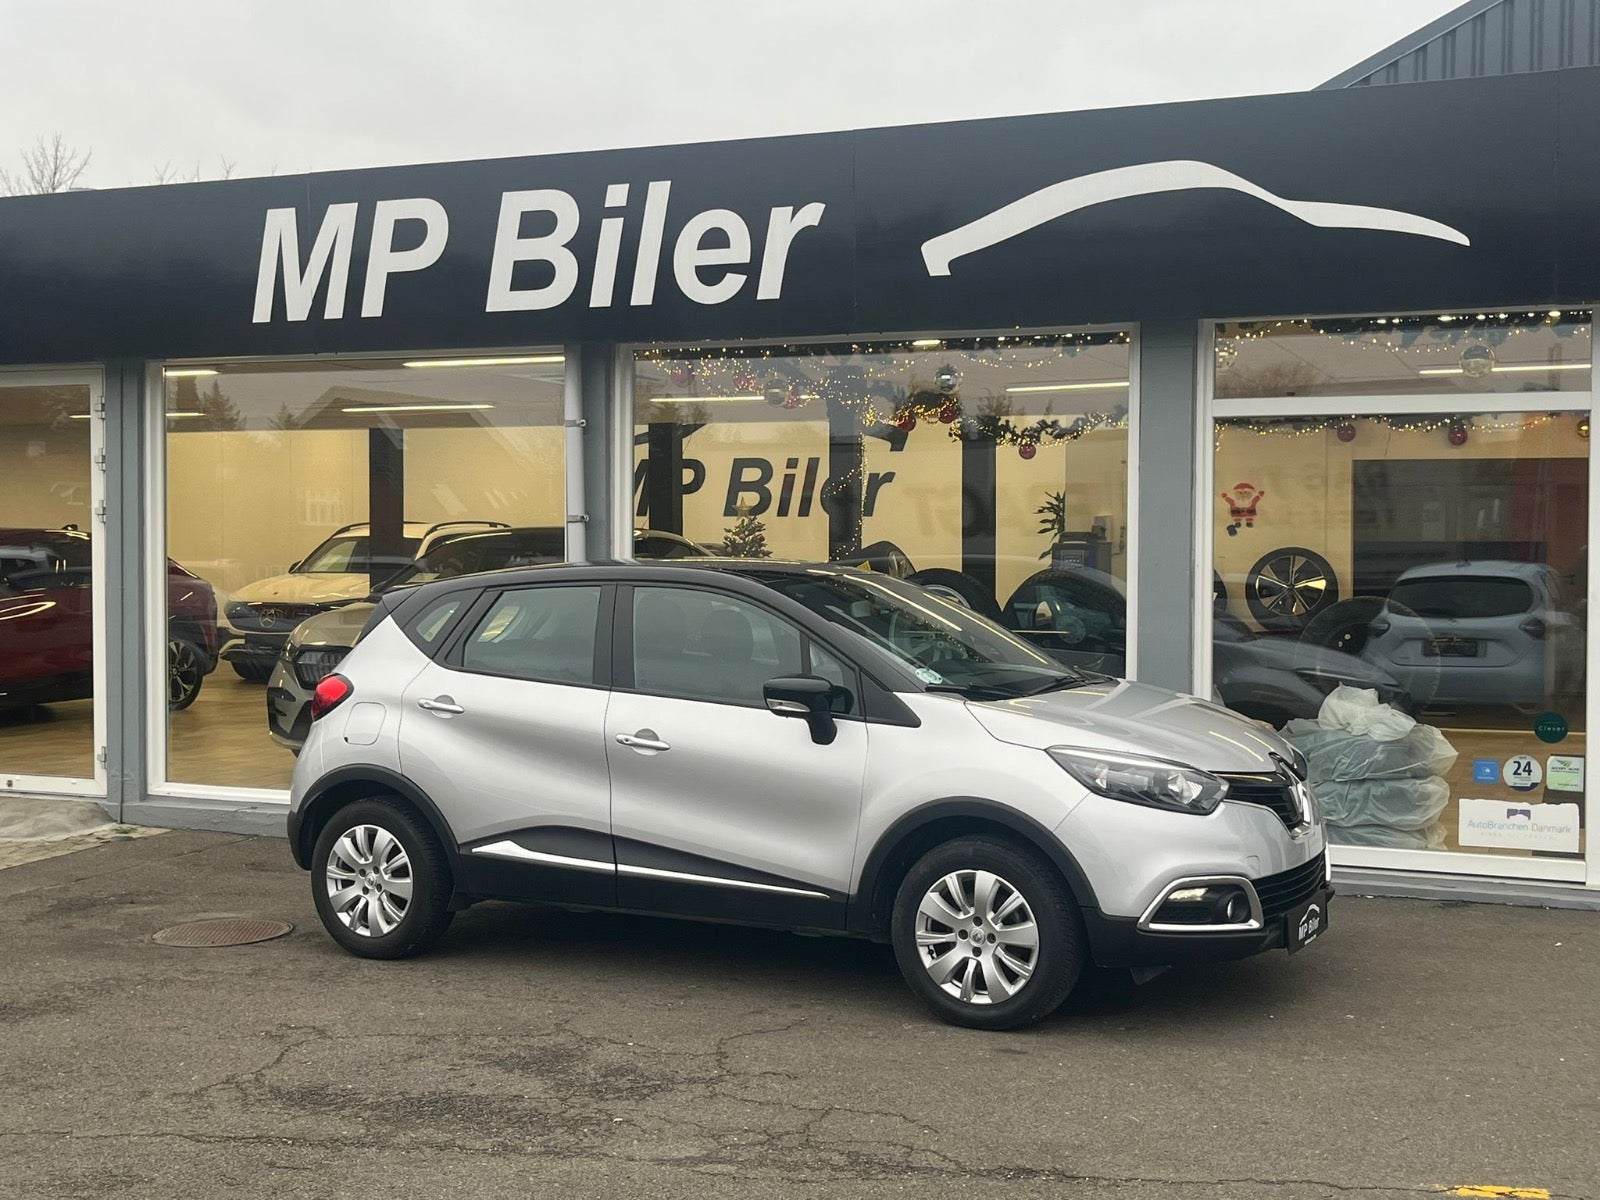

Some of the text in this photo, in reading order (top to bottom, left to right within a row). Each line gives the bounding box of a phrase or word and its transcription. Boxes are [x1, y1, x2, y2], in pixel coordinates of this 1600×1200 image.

[252, 180, 826, 323] MP Biler
[723, 457, 896, 517] Bilr
[1512, 760, 1533, 776] 24
[1467, 820, 1571, 834] AutoBranchen Danmark
